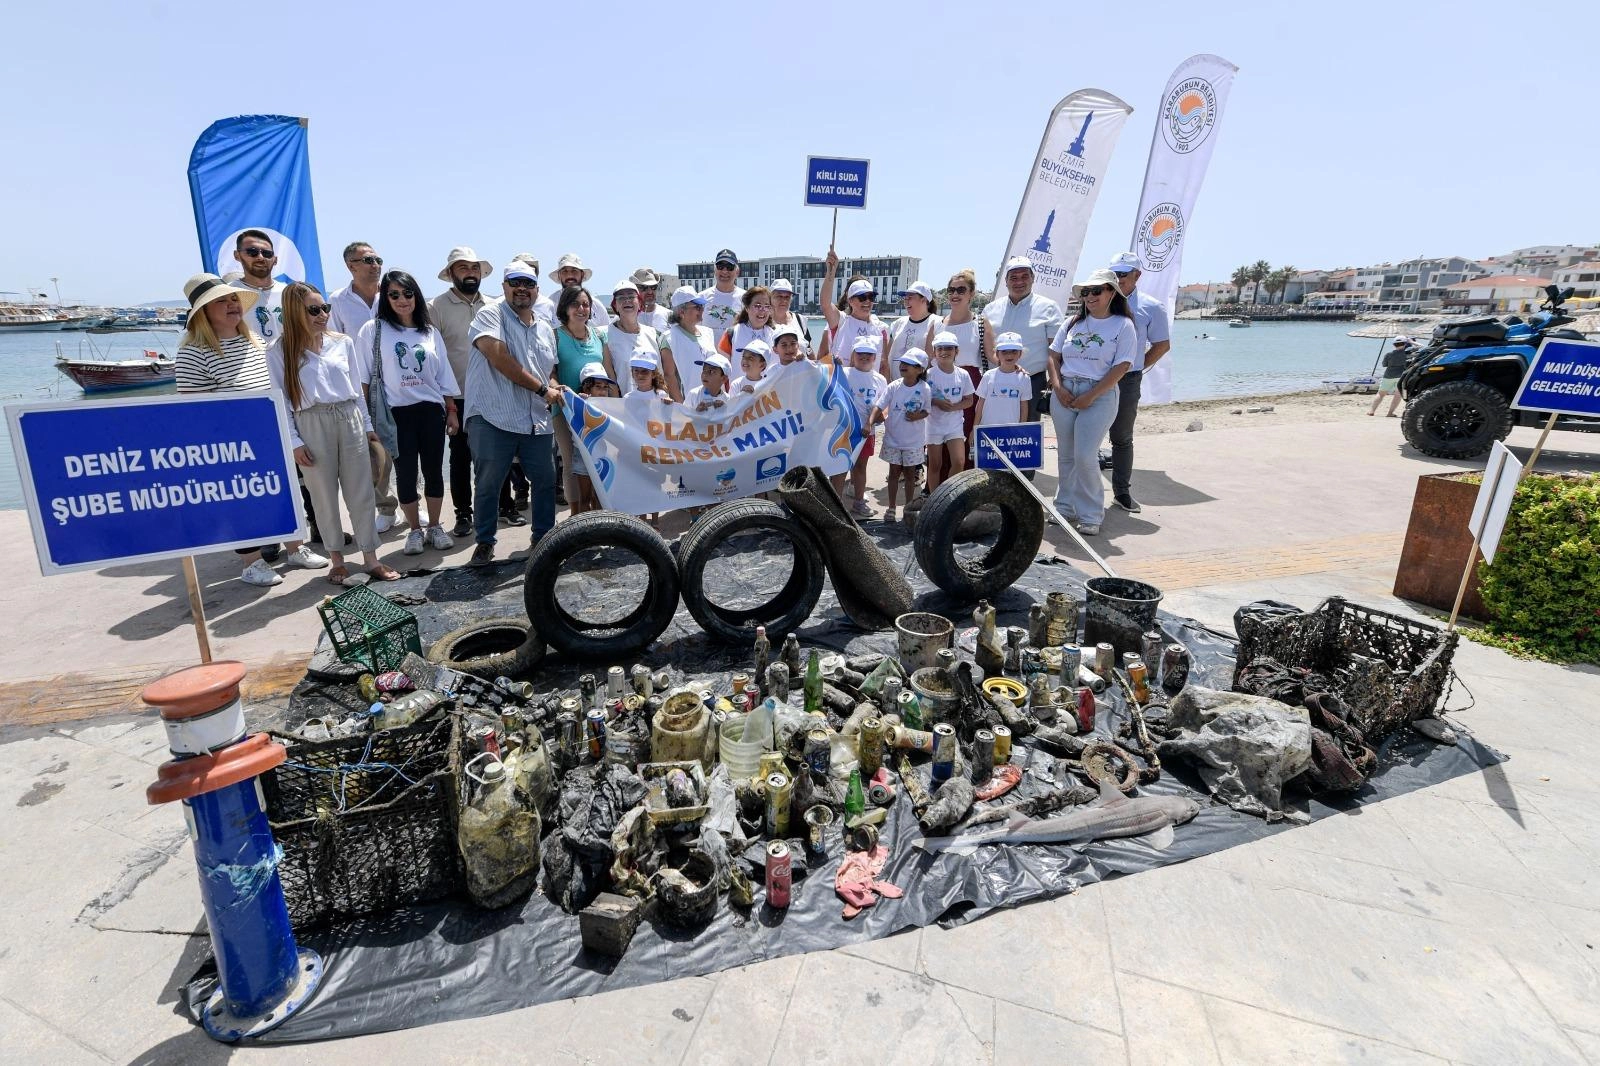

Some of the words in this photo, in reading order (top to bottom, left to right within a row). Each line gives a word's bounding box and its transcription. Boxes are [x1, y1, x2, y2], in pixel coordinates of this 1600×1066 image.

[1165, 81, 1200, 120] KARABURUN
[816, 169, 837, 181] KİRLİ
[838, 172, 859, 182] SUDA
[810, 184, 835, 195] HAYAT
[836, 186, 863, 197] OLMAZ
[1542, 361, 1574, 375] MAVİ
[1530, 380, 1594, 396] GELECEĞİN
[640, 439, 732, 465] RENGİ:
[733, 409, 805, 453] MAVİ!
[1006, 436, 1033, 446] VARSA
[63, 445, 146, 479] DENİZ
[150, 440, 256, 470] KORUMA
[1014, 450, 1031, 459] VAR
[51, 491, 124, 526] ŞUBE
[130, 472, 282, 512] MÜDÜRLÜĞÜ
